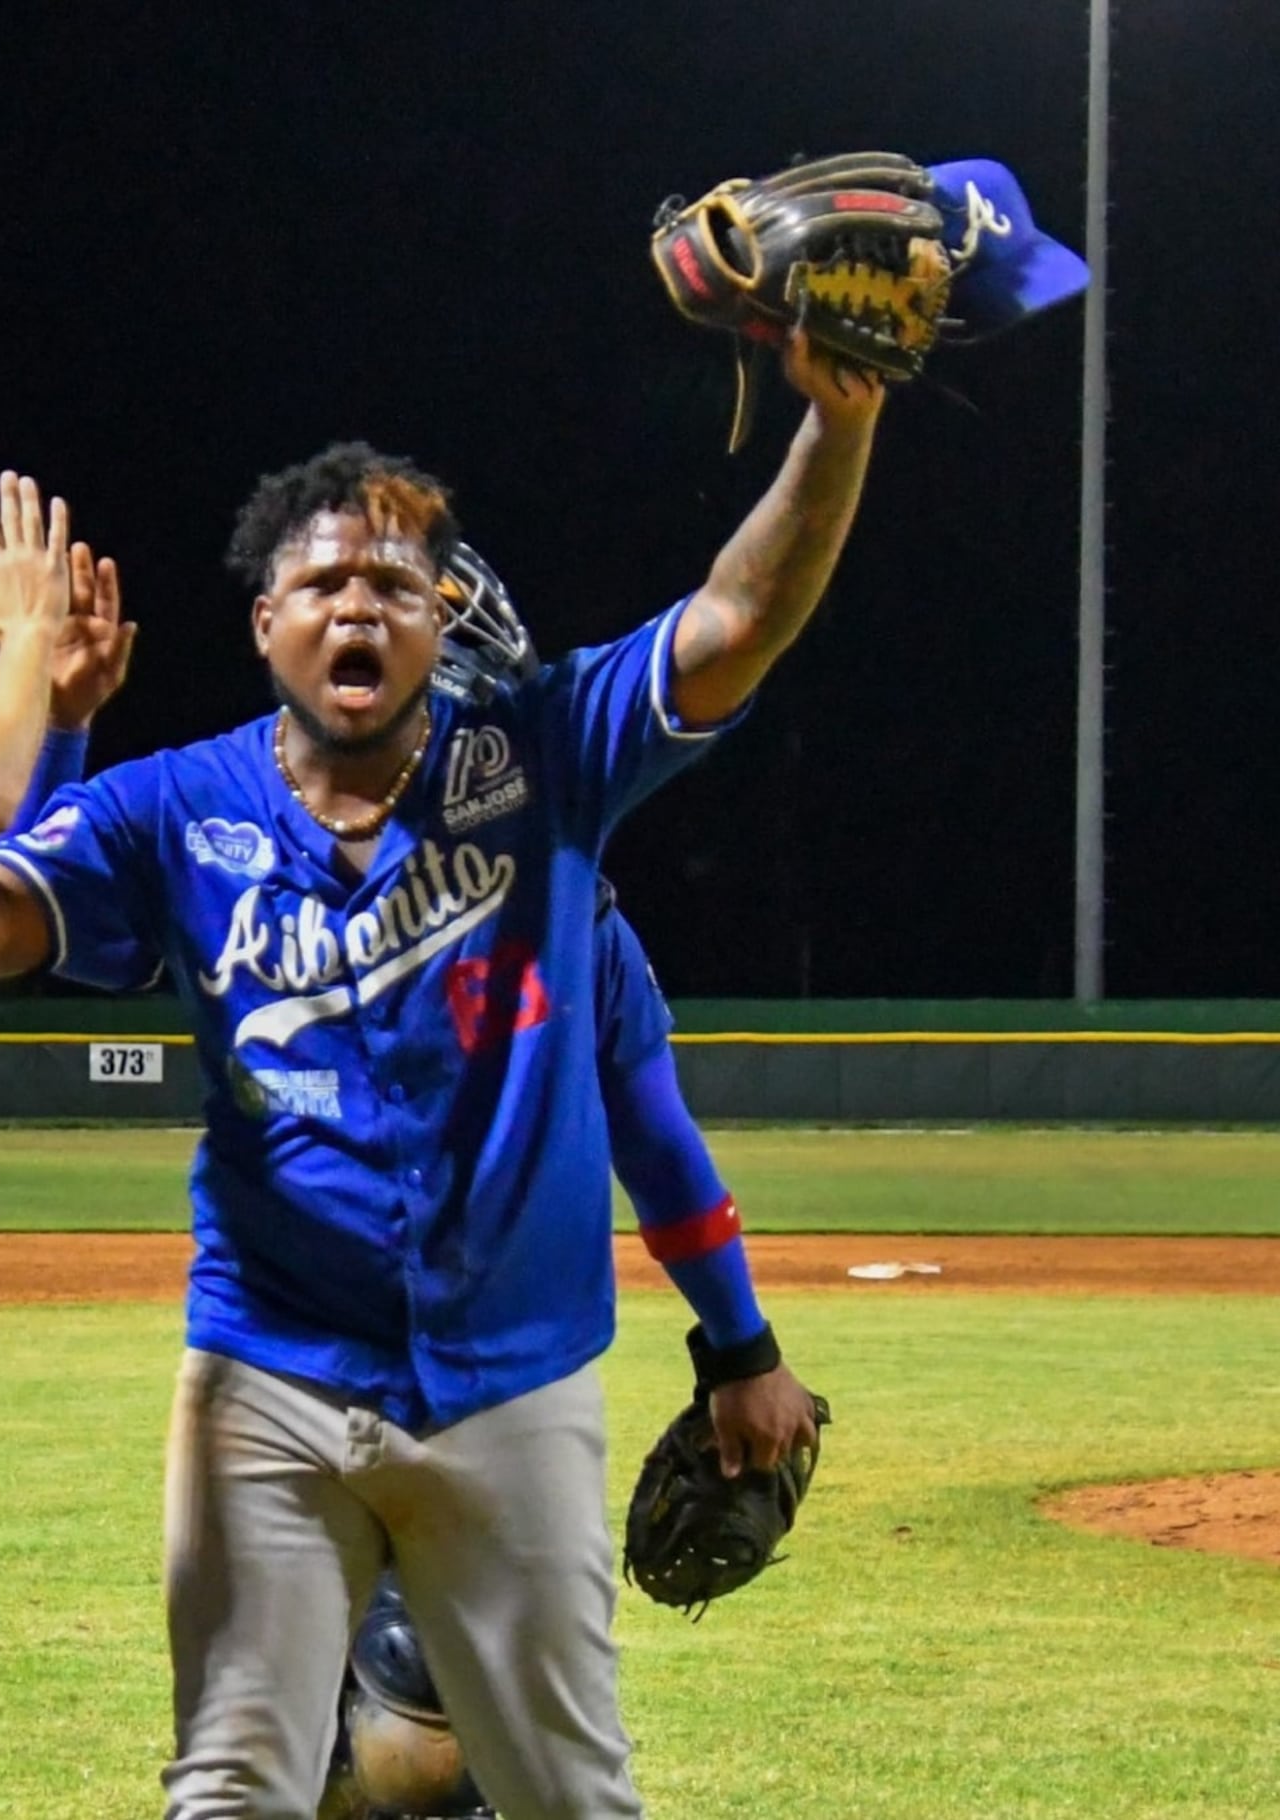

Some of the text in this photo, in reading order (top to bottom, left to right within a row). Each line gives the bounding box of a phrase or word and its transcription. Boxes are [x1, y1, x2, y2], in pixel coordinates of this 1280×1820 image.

[951, 180, 1011, 260] A
[199, 840, 516, 996] Aibonito
[100, 1048, 144, 1076] 373
